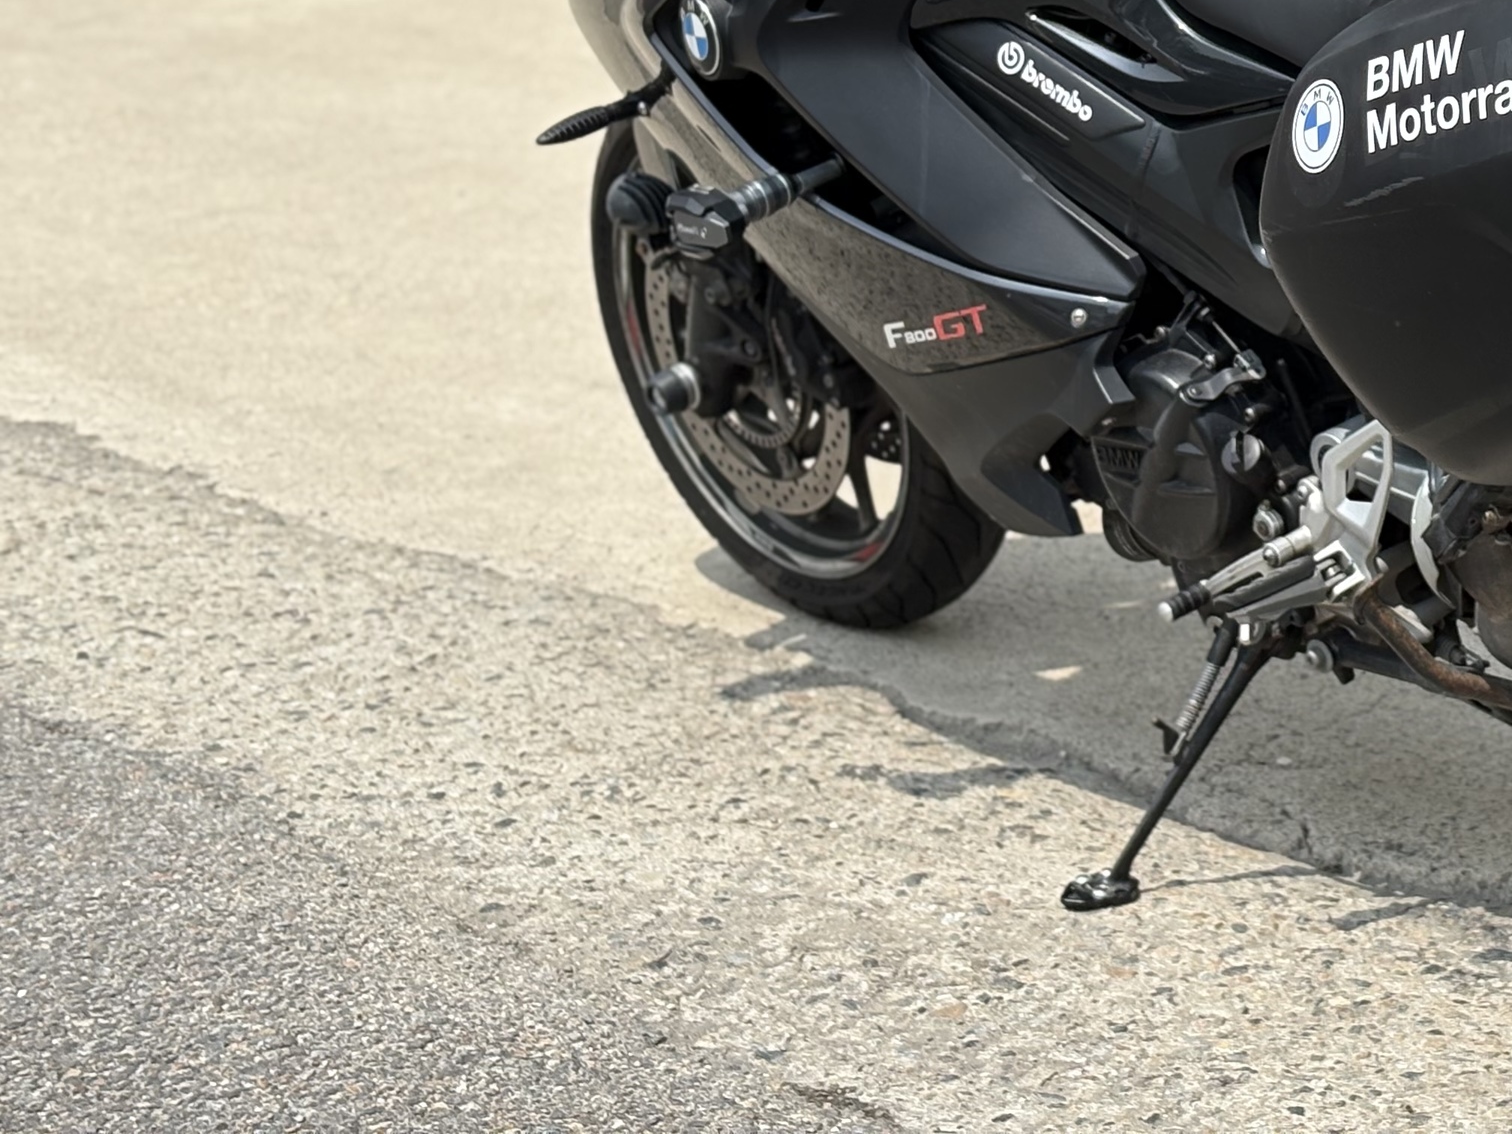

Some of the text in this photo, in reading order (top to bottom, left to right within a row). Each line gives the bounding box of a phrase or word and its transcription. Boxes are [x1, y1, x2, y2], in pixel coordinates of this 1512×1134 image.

[1021, 58, 1093, 122] brembo
[1366, 29, 1466, 102] BMW
[1300, 88, 1335, 117] BMW
